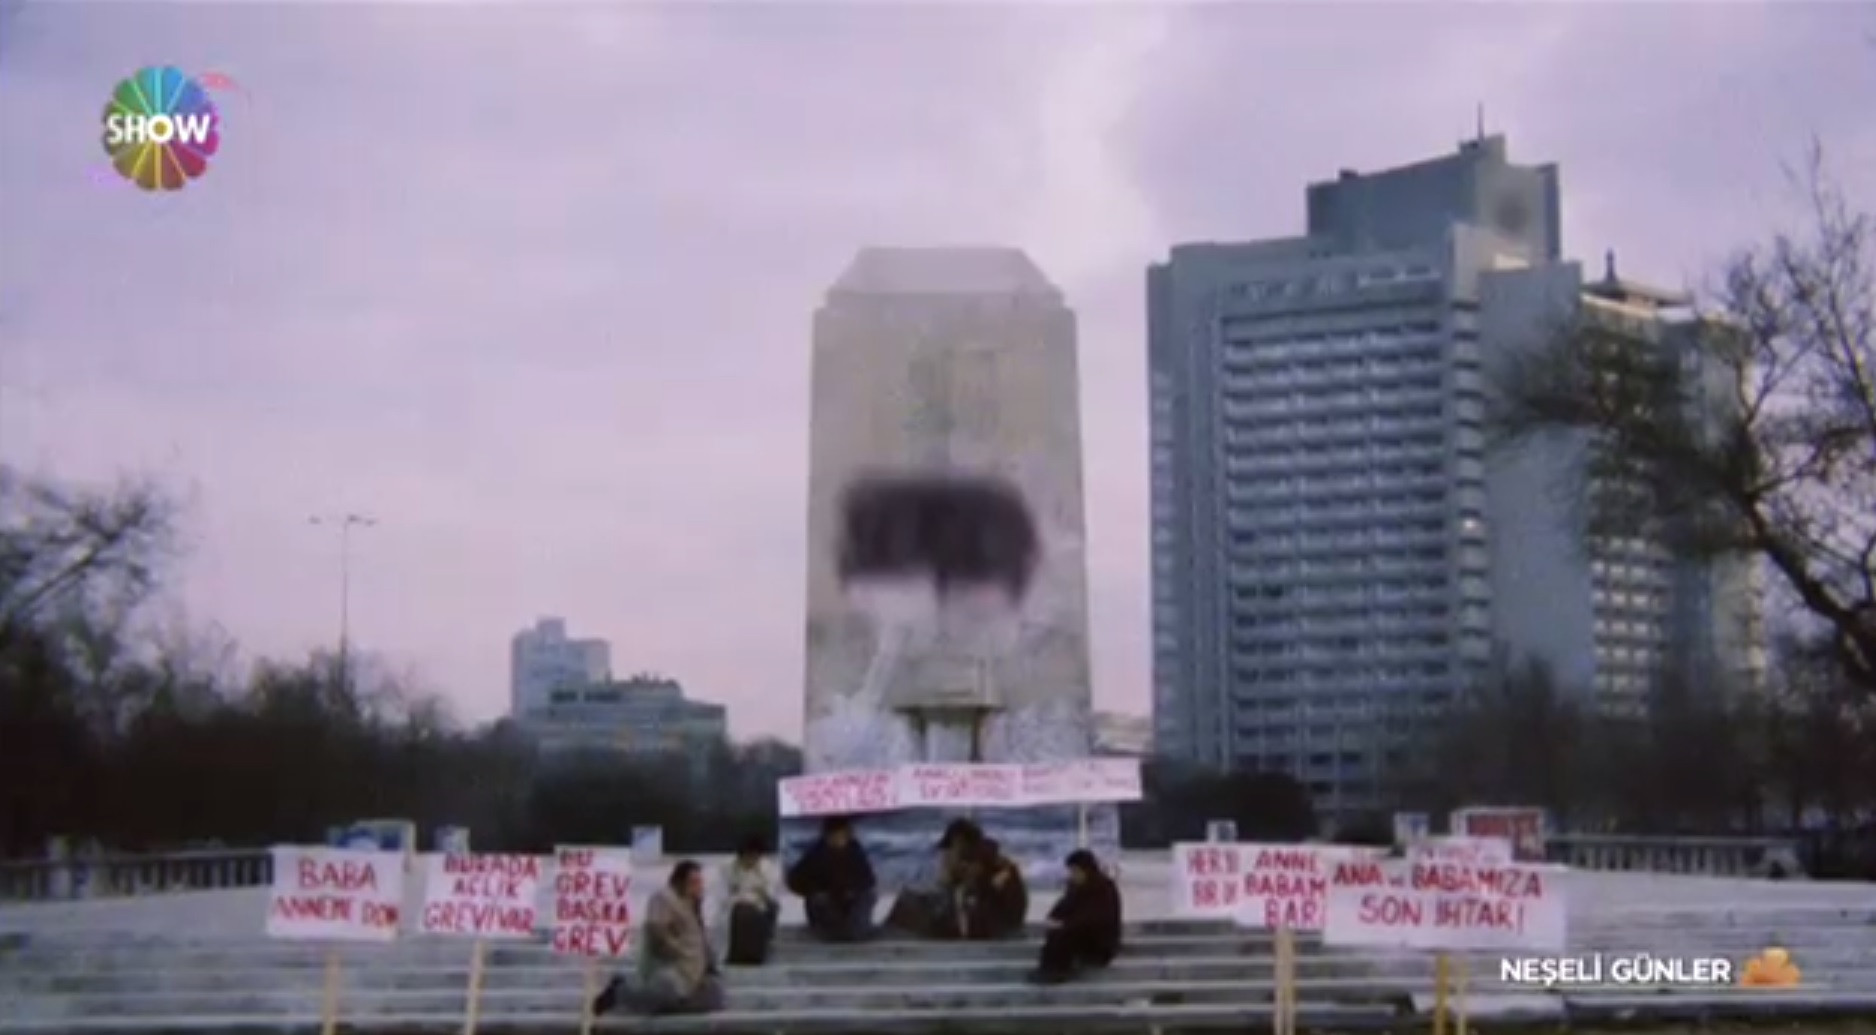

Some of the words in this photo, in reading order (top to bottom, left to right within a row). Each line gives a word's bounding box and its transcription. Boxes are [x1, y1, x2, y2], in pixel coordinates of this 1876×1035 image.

[298, 858, 378, 891] BABA
[555, 871, 631, 898] GREV
[1333, 862, 1383, 886] ANA
[1411, 864, 1542, 898] BABAMIZA
[1358, 894, 1422, 925] SON
[553, 926, 629, 956] GREV
